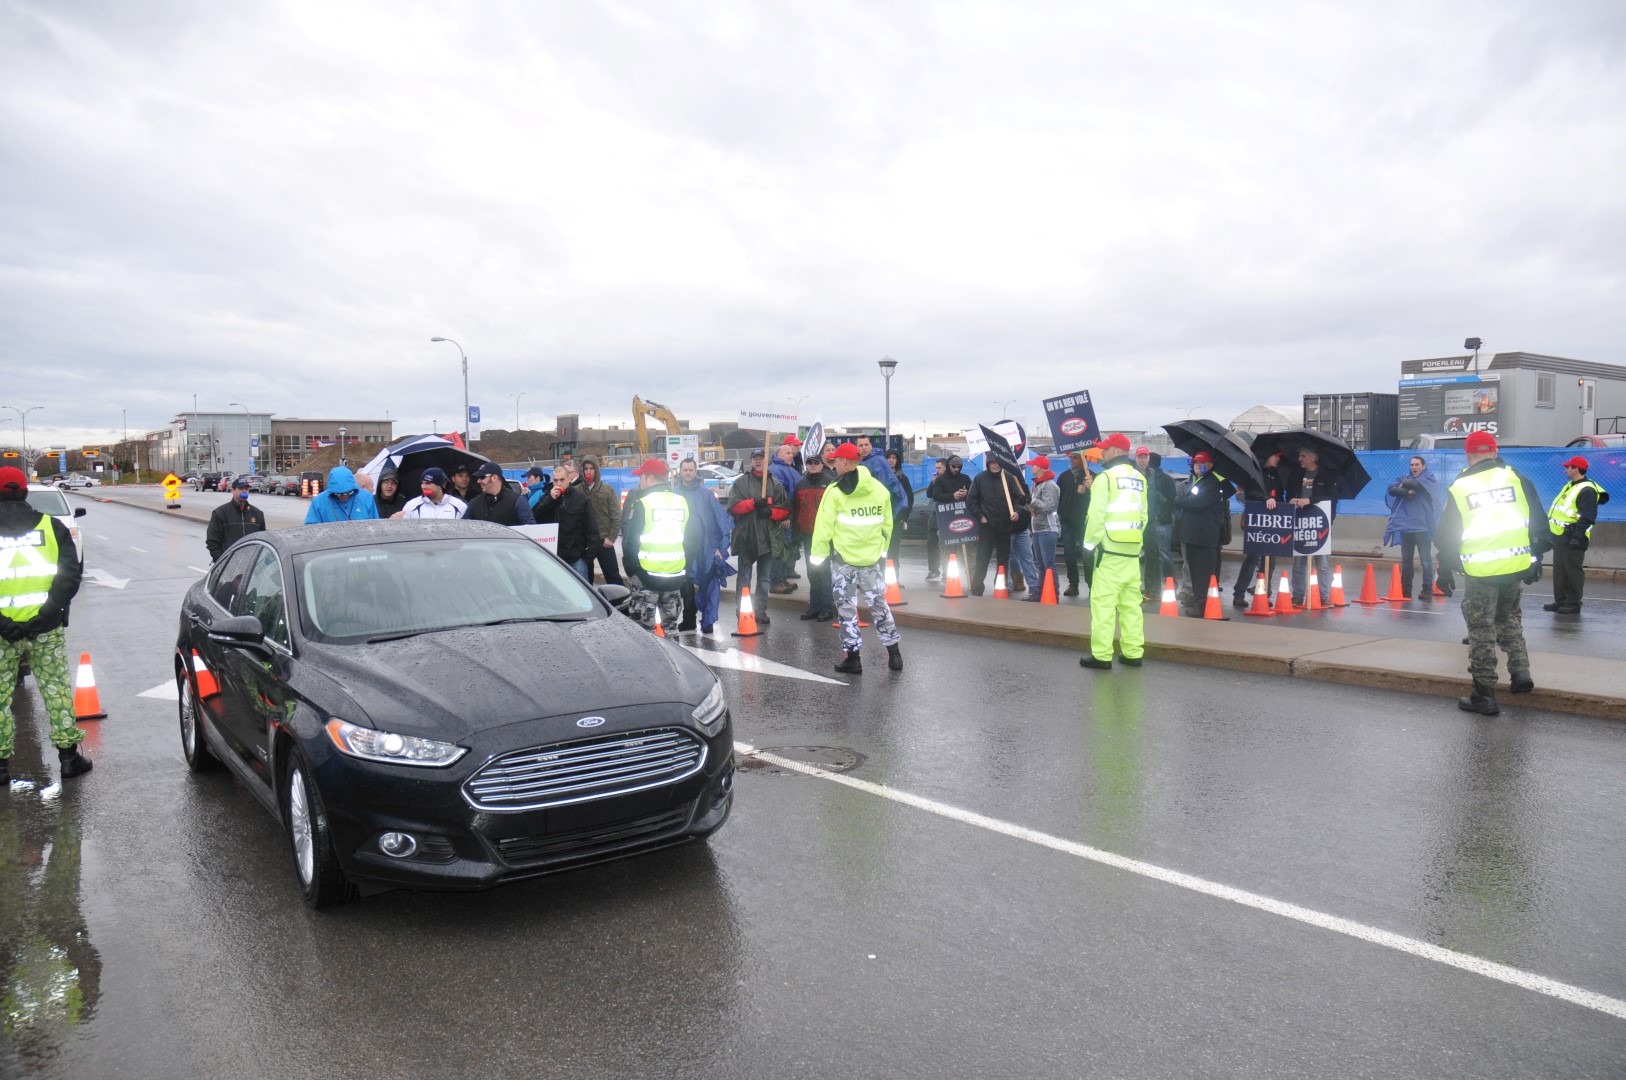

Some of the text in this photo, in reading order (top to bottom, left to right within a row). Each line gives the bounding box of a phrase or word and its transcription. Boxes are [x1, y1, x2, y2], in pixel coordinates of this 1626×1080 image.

[1422, 359, 1465, 367] POMERLEAU
[1074, 391, 1089, 405] VOLÉ
[749, 411, 798, 421] gouvernement
[1462, 421, 1498, 434] VIES
[1059, 439, 1093, 451] LIBRE NÉGO
[850, 505, 883, 517] POLICE
[1247, 513, 1293, 529] LIBRE
[1293, 516, 1323, 529] LIBRE
[1246, 531, 1281, 544] NÉGO
[1293, 528, 1317, 542] NÉGO
